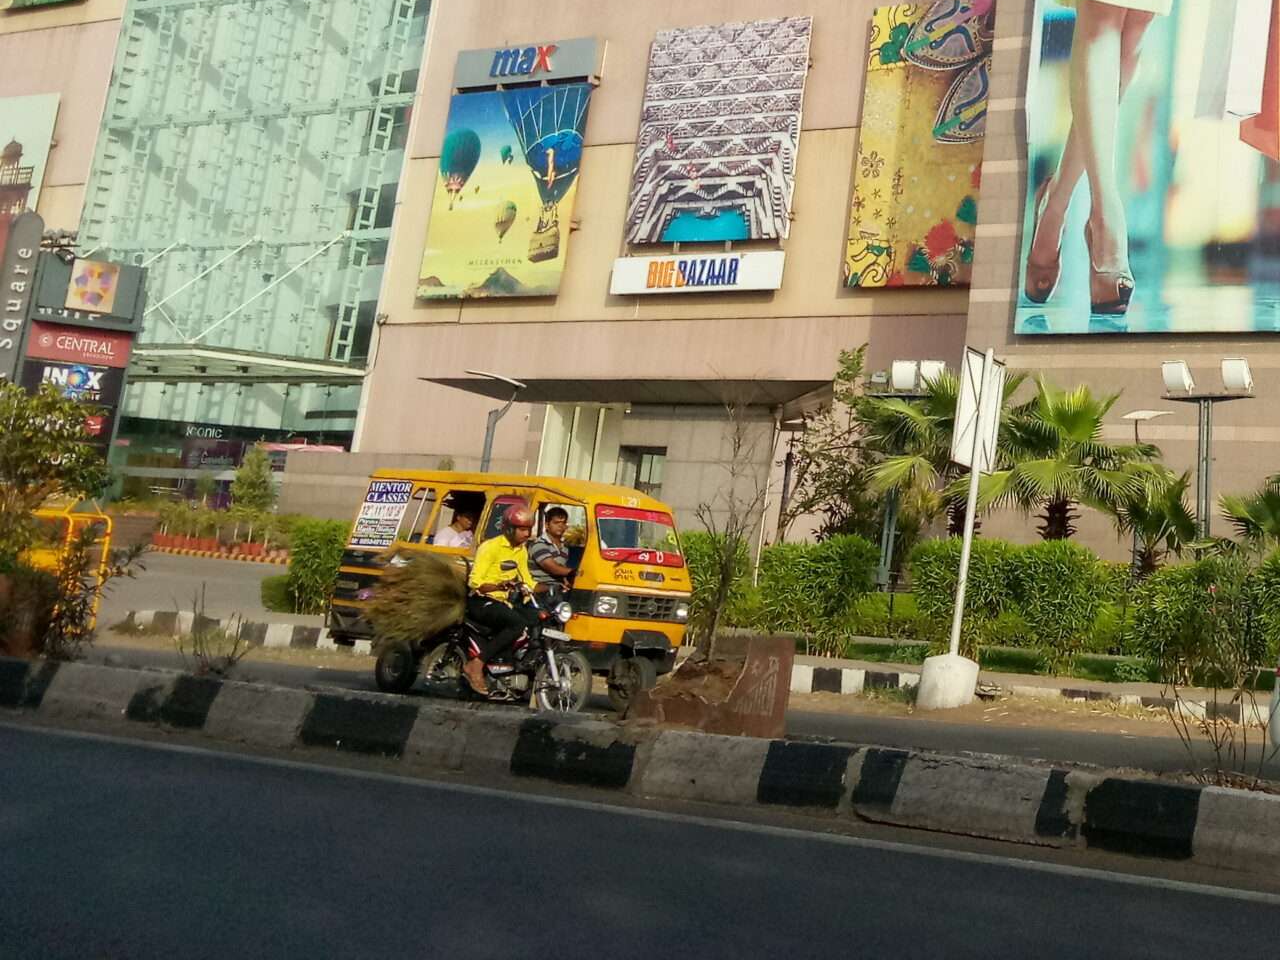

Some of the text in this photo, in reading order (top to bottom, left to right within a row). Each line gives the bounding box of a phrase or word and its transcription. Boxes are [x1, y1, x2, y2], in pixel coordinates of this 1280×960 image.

[489, 45, 559, 77] max
[647, 258, 739, 288] BIG BAZAAR
[56, 335, 115, 355] CENTRAL
[367, 492, 409, 502] CLASSES
[370, 482, 412, 492] MENTOR
